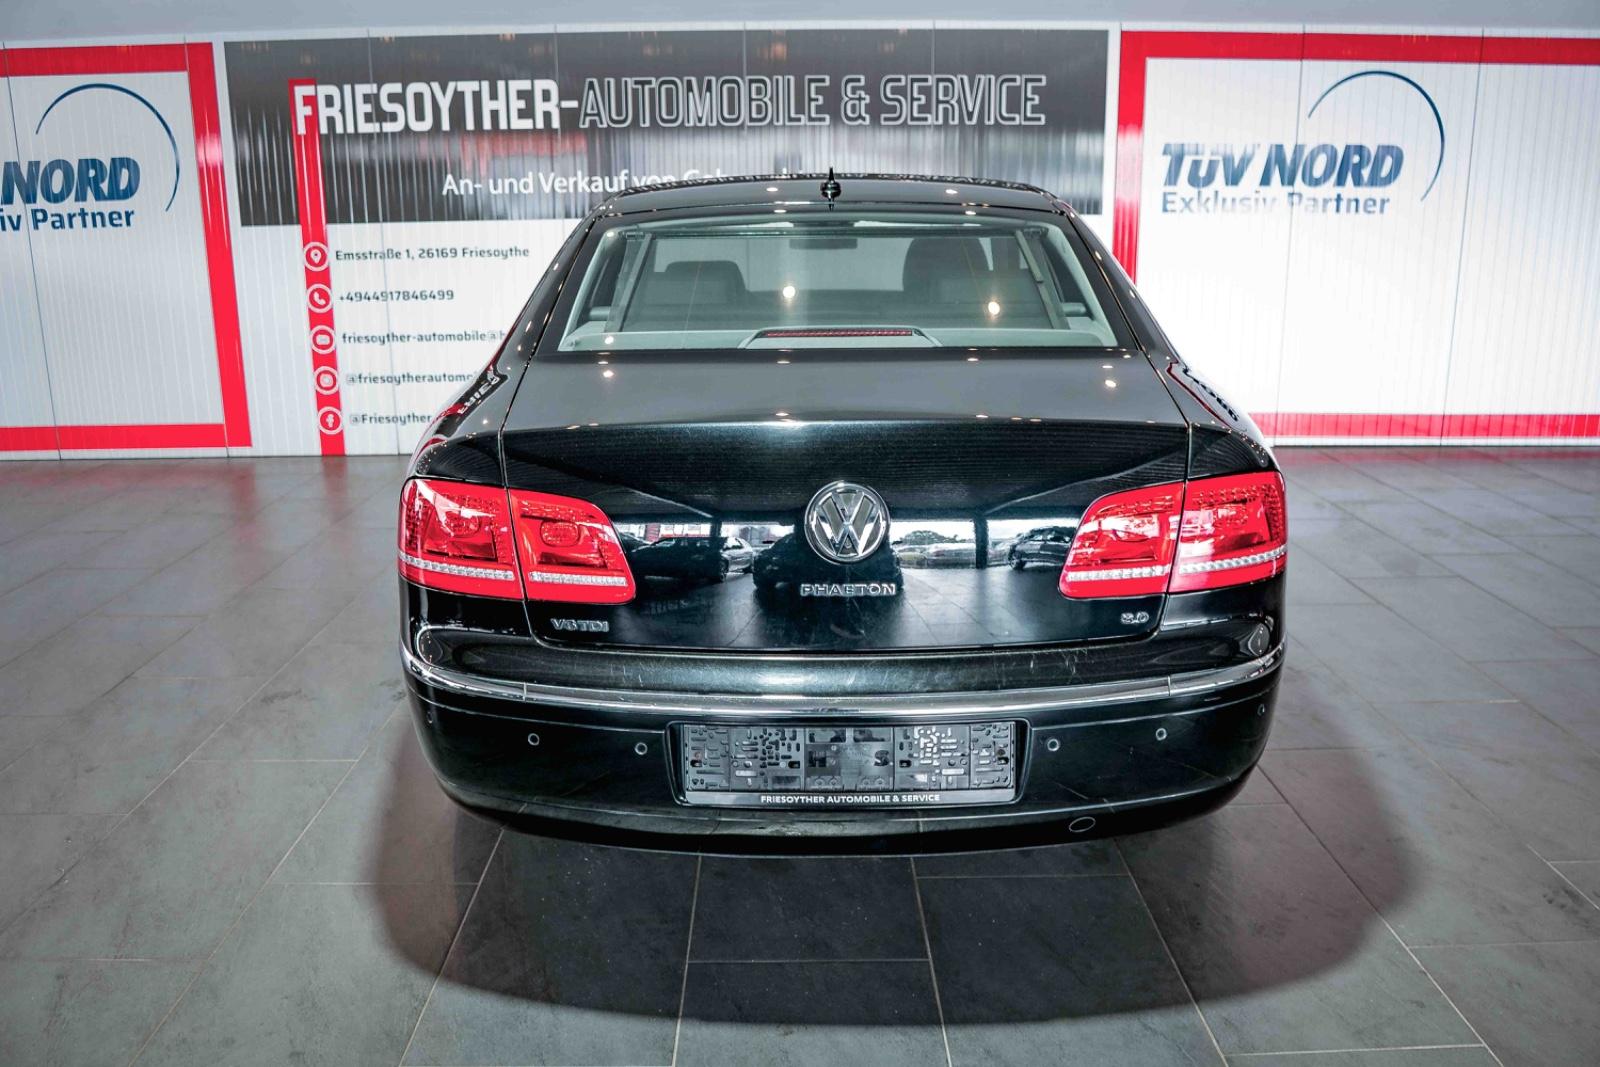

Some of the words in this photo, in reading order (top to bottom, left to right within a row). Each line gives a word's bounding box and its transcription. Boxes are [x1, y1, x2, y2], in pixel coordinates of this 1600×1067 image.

[840, 75, 869, 124] &
[880, 74, 1046, 126] SERVICE
[1259, 143, 1404, 188] NORD
[0, 157, 141, 205] NORD
[442, 174, 483, 196] An-
[489, 172, 534, 195] und
[538, 169, 629, 193] Verkauf
[1162, 190, 1277, 214] Exklusiv
[1288, 192, 1390, 214] Partner
[31, 207, 135, 231] Partner
[335, 249, 402, 261] Emsstraße
[405, 249, 415, 261] 1,
[418, 248, 458, 259] 26169
[462, 246, 530, 260] Friesoythe
[339, 289, 455, 302] +4944917846499
[800, 583, 897, 597] PHAETON
[760, 795, 825, 804] FRIESOYTHER
[826, 794, 890, 803] AUTOMOBILE
[892, 794, 899, 802] &
[901, 794, 941, 802] SERVICE
